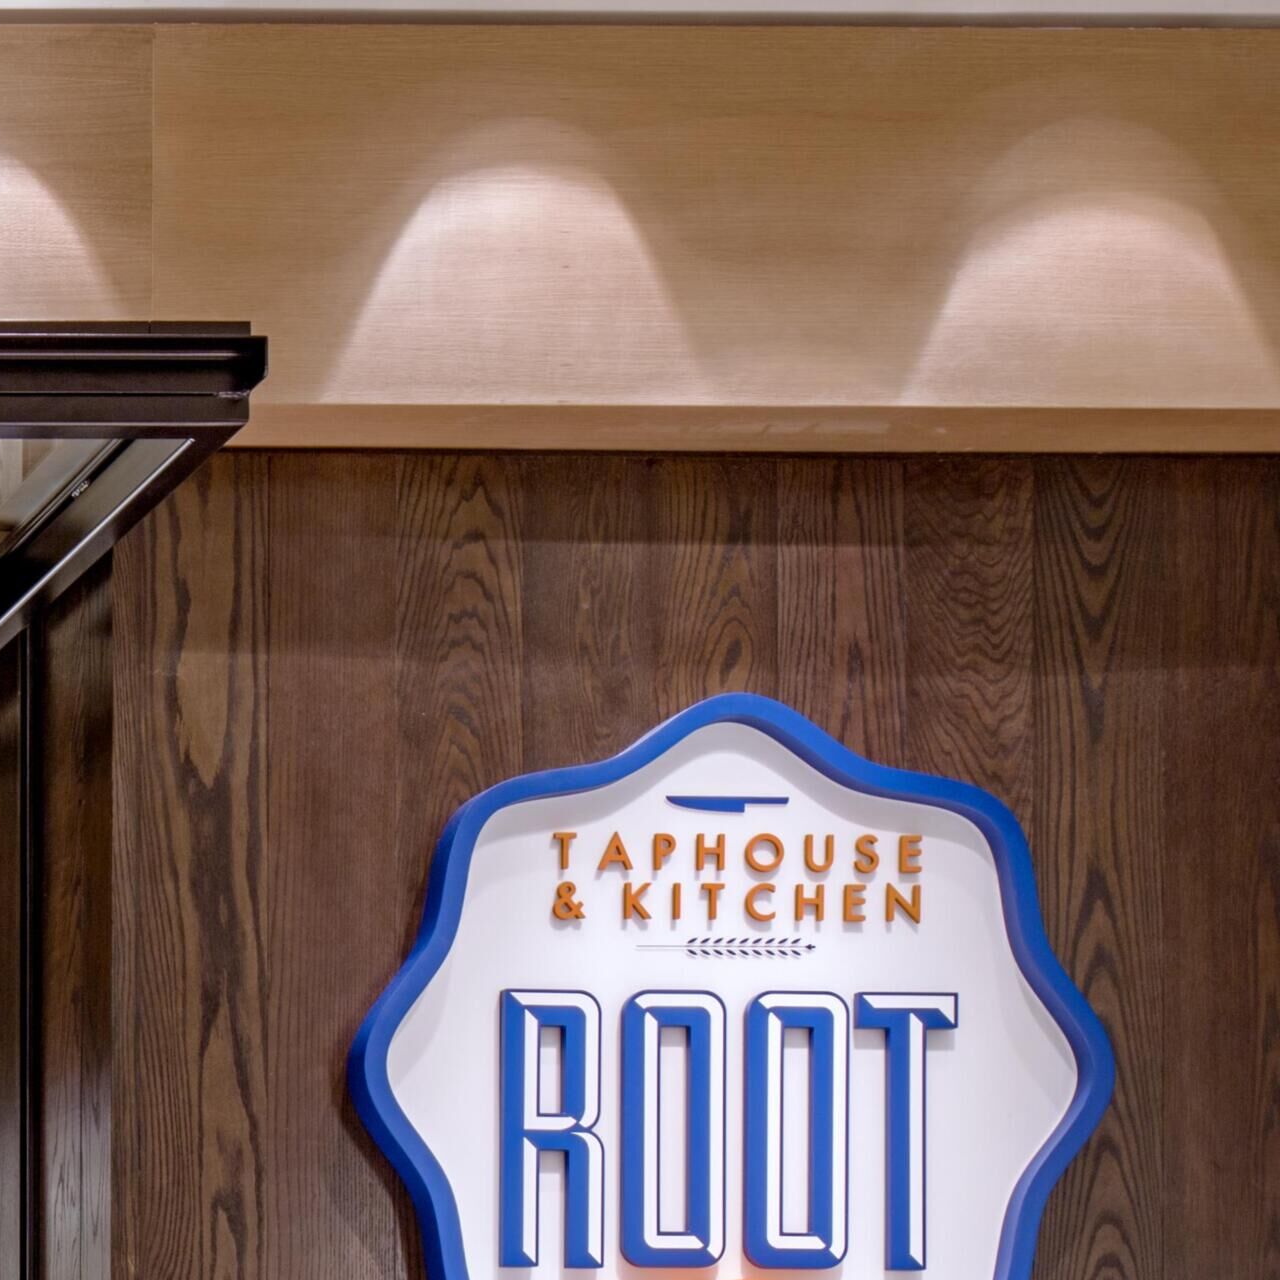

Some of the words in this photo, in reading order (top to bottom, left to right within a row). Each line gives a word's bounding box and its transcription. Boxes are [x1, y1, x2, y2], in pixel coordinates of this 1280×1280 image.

[552, 831, 924, 874] TAPHOUSE
[552, 882, 584, 922] &
[622, 881, 924, 924] KITCHEN
[498, 988, 959, 1271] ROOT
